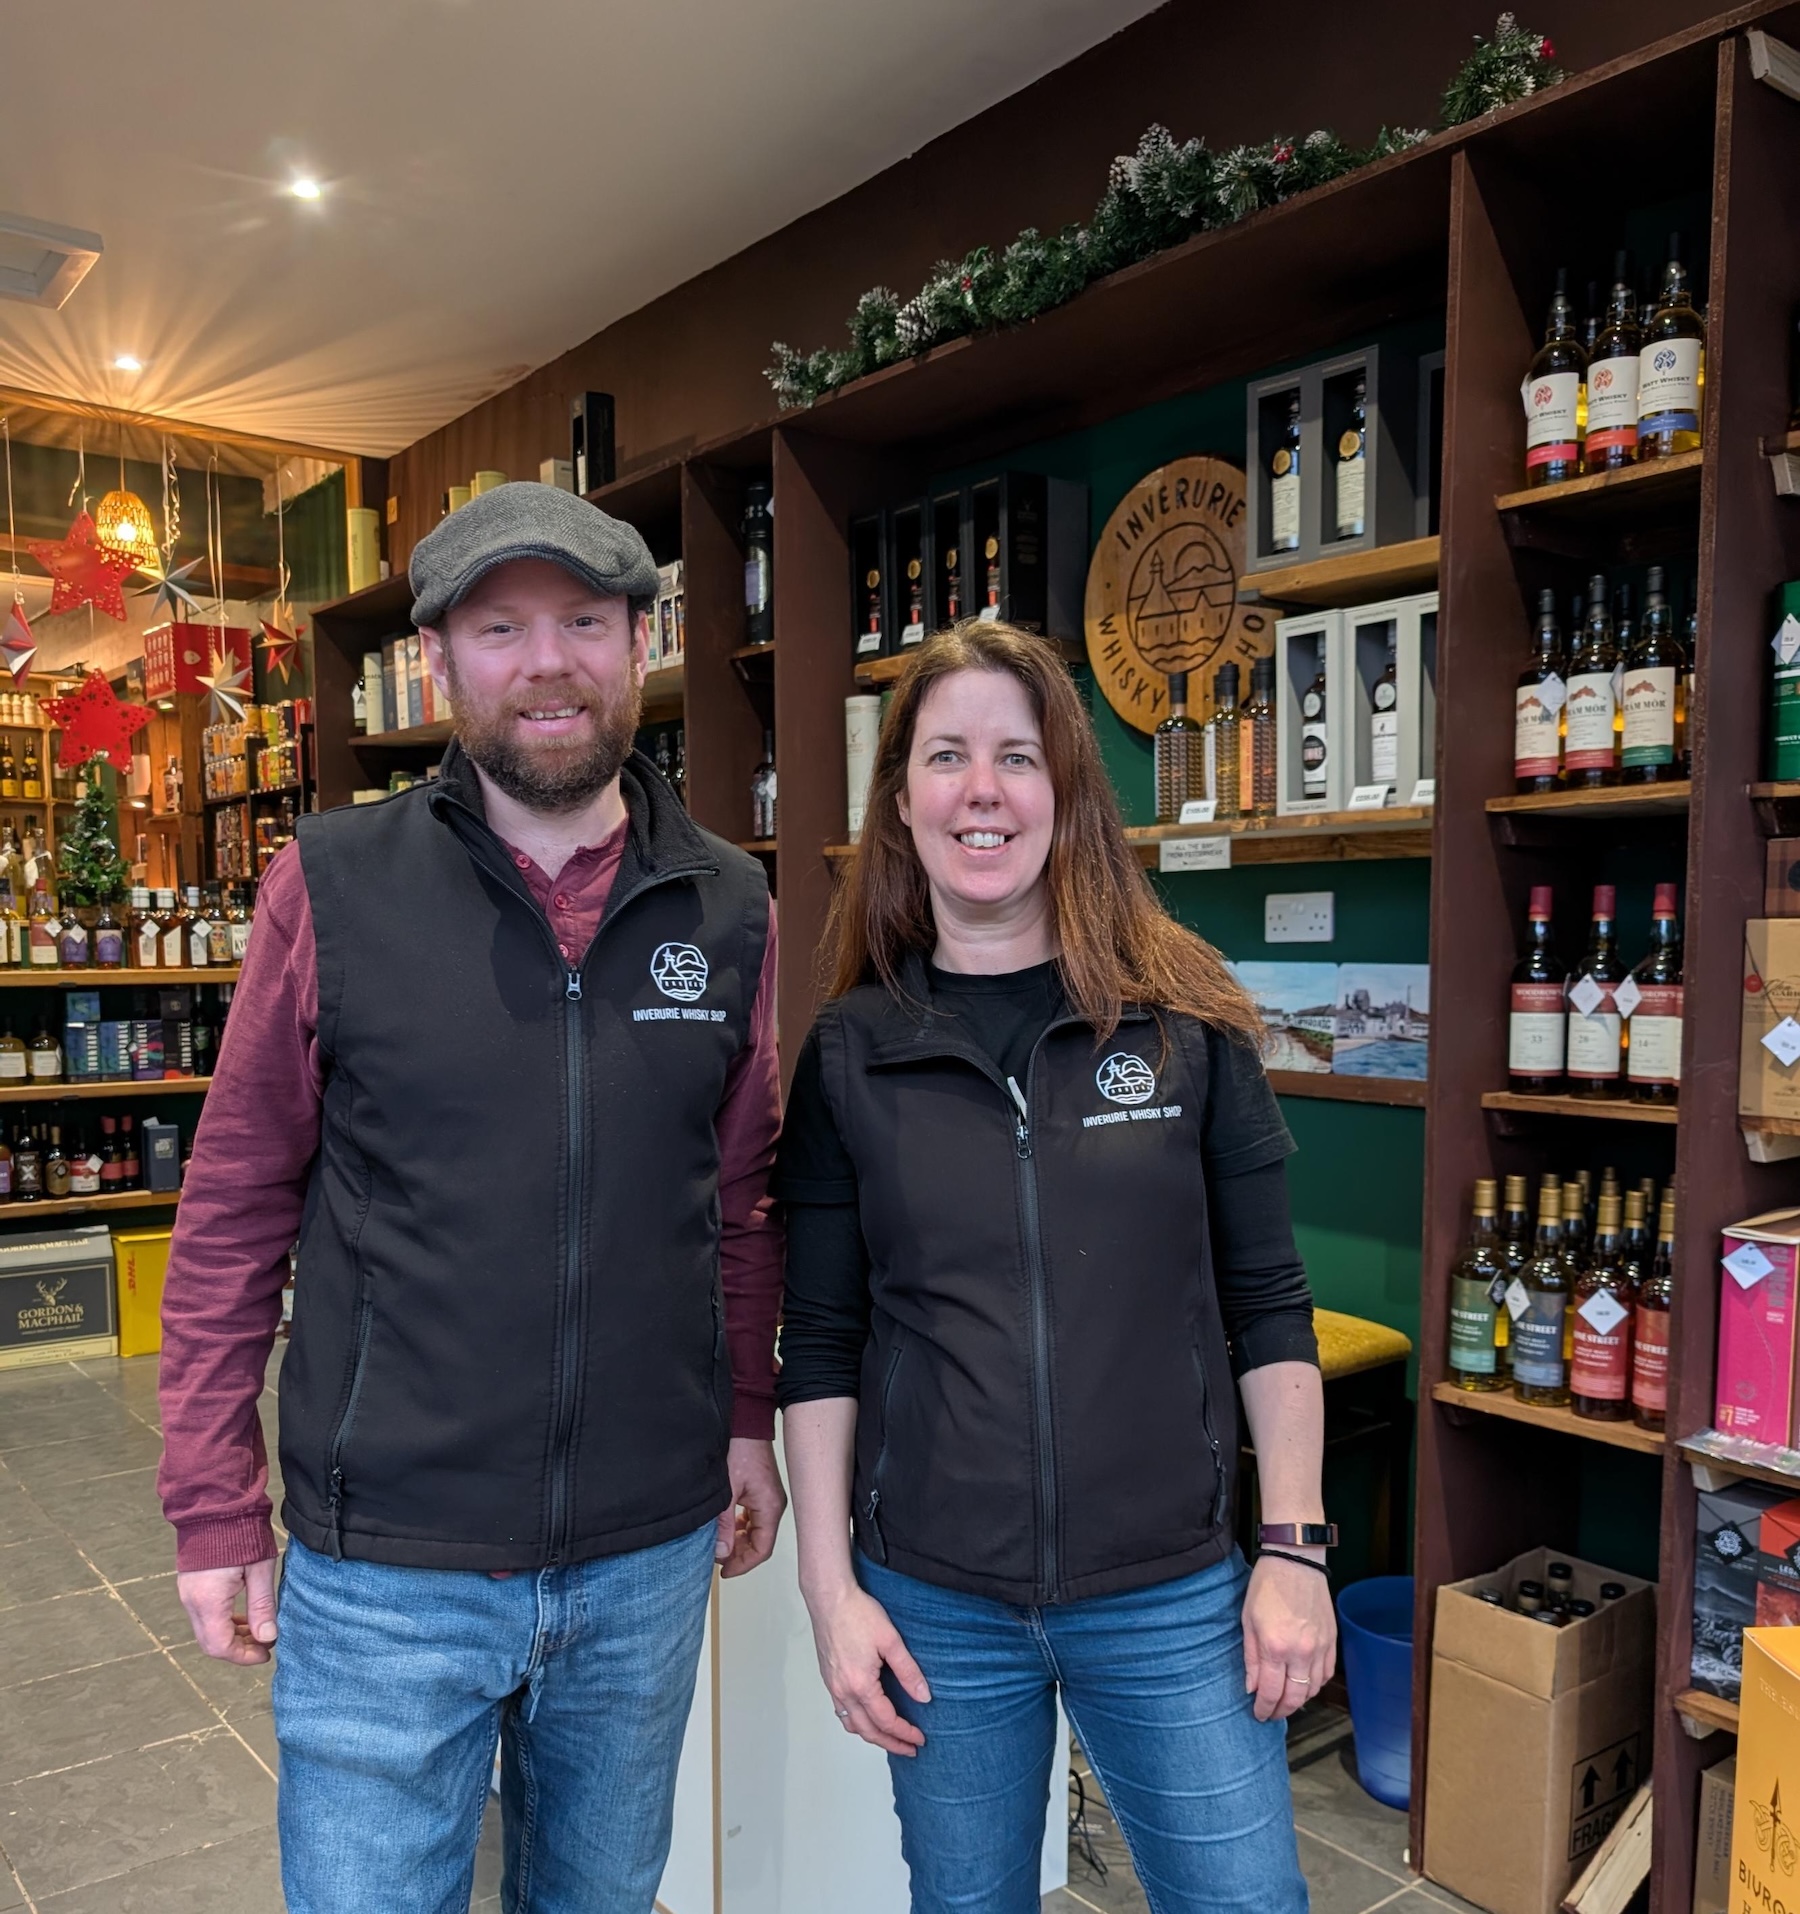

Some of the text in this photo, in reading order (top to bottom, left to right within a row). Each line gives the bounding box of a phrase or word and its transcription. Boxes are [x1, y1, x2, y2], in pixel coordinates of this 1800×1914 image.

[1660, 376, 1690, 384] WHISKY
[1116, 477, 1247, 550] INVERURIE
[1098, 612, 1166, 714] WHISKY
[633, 1007, 726, 1022] INVERURIE WHISKY SHOP
[1083, 1105, 1182, 1128] INVERURIE WHISKY SHOP
[127, 1257, 136, 1290] DHL
[18, 1313, 84, 1329] MACPHAIL
[1528, 1323, 1557, 1335] STREET
[1588, 1333, 1619, 1346] STREET
[1739, 1858, 1799, 1914] BIVRO
